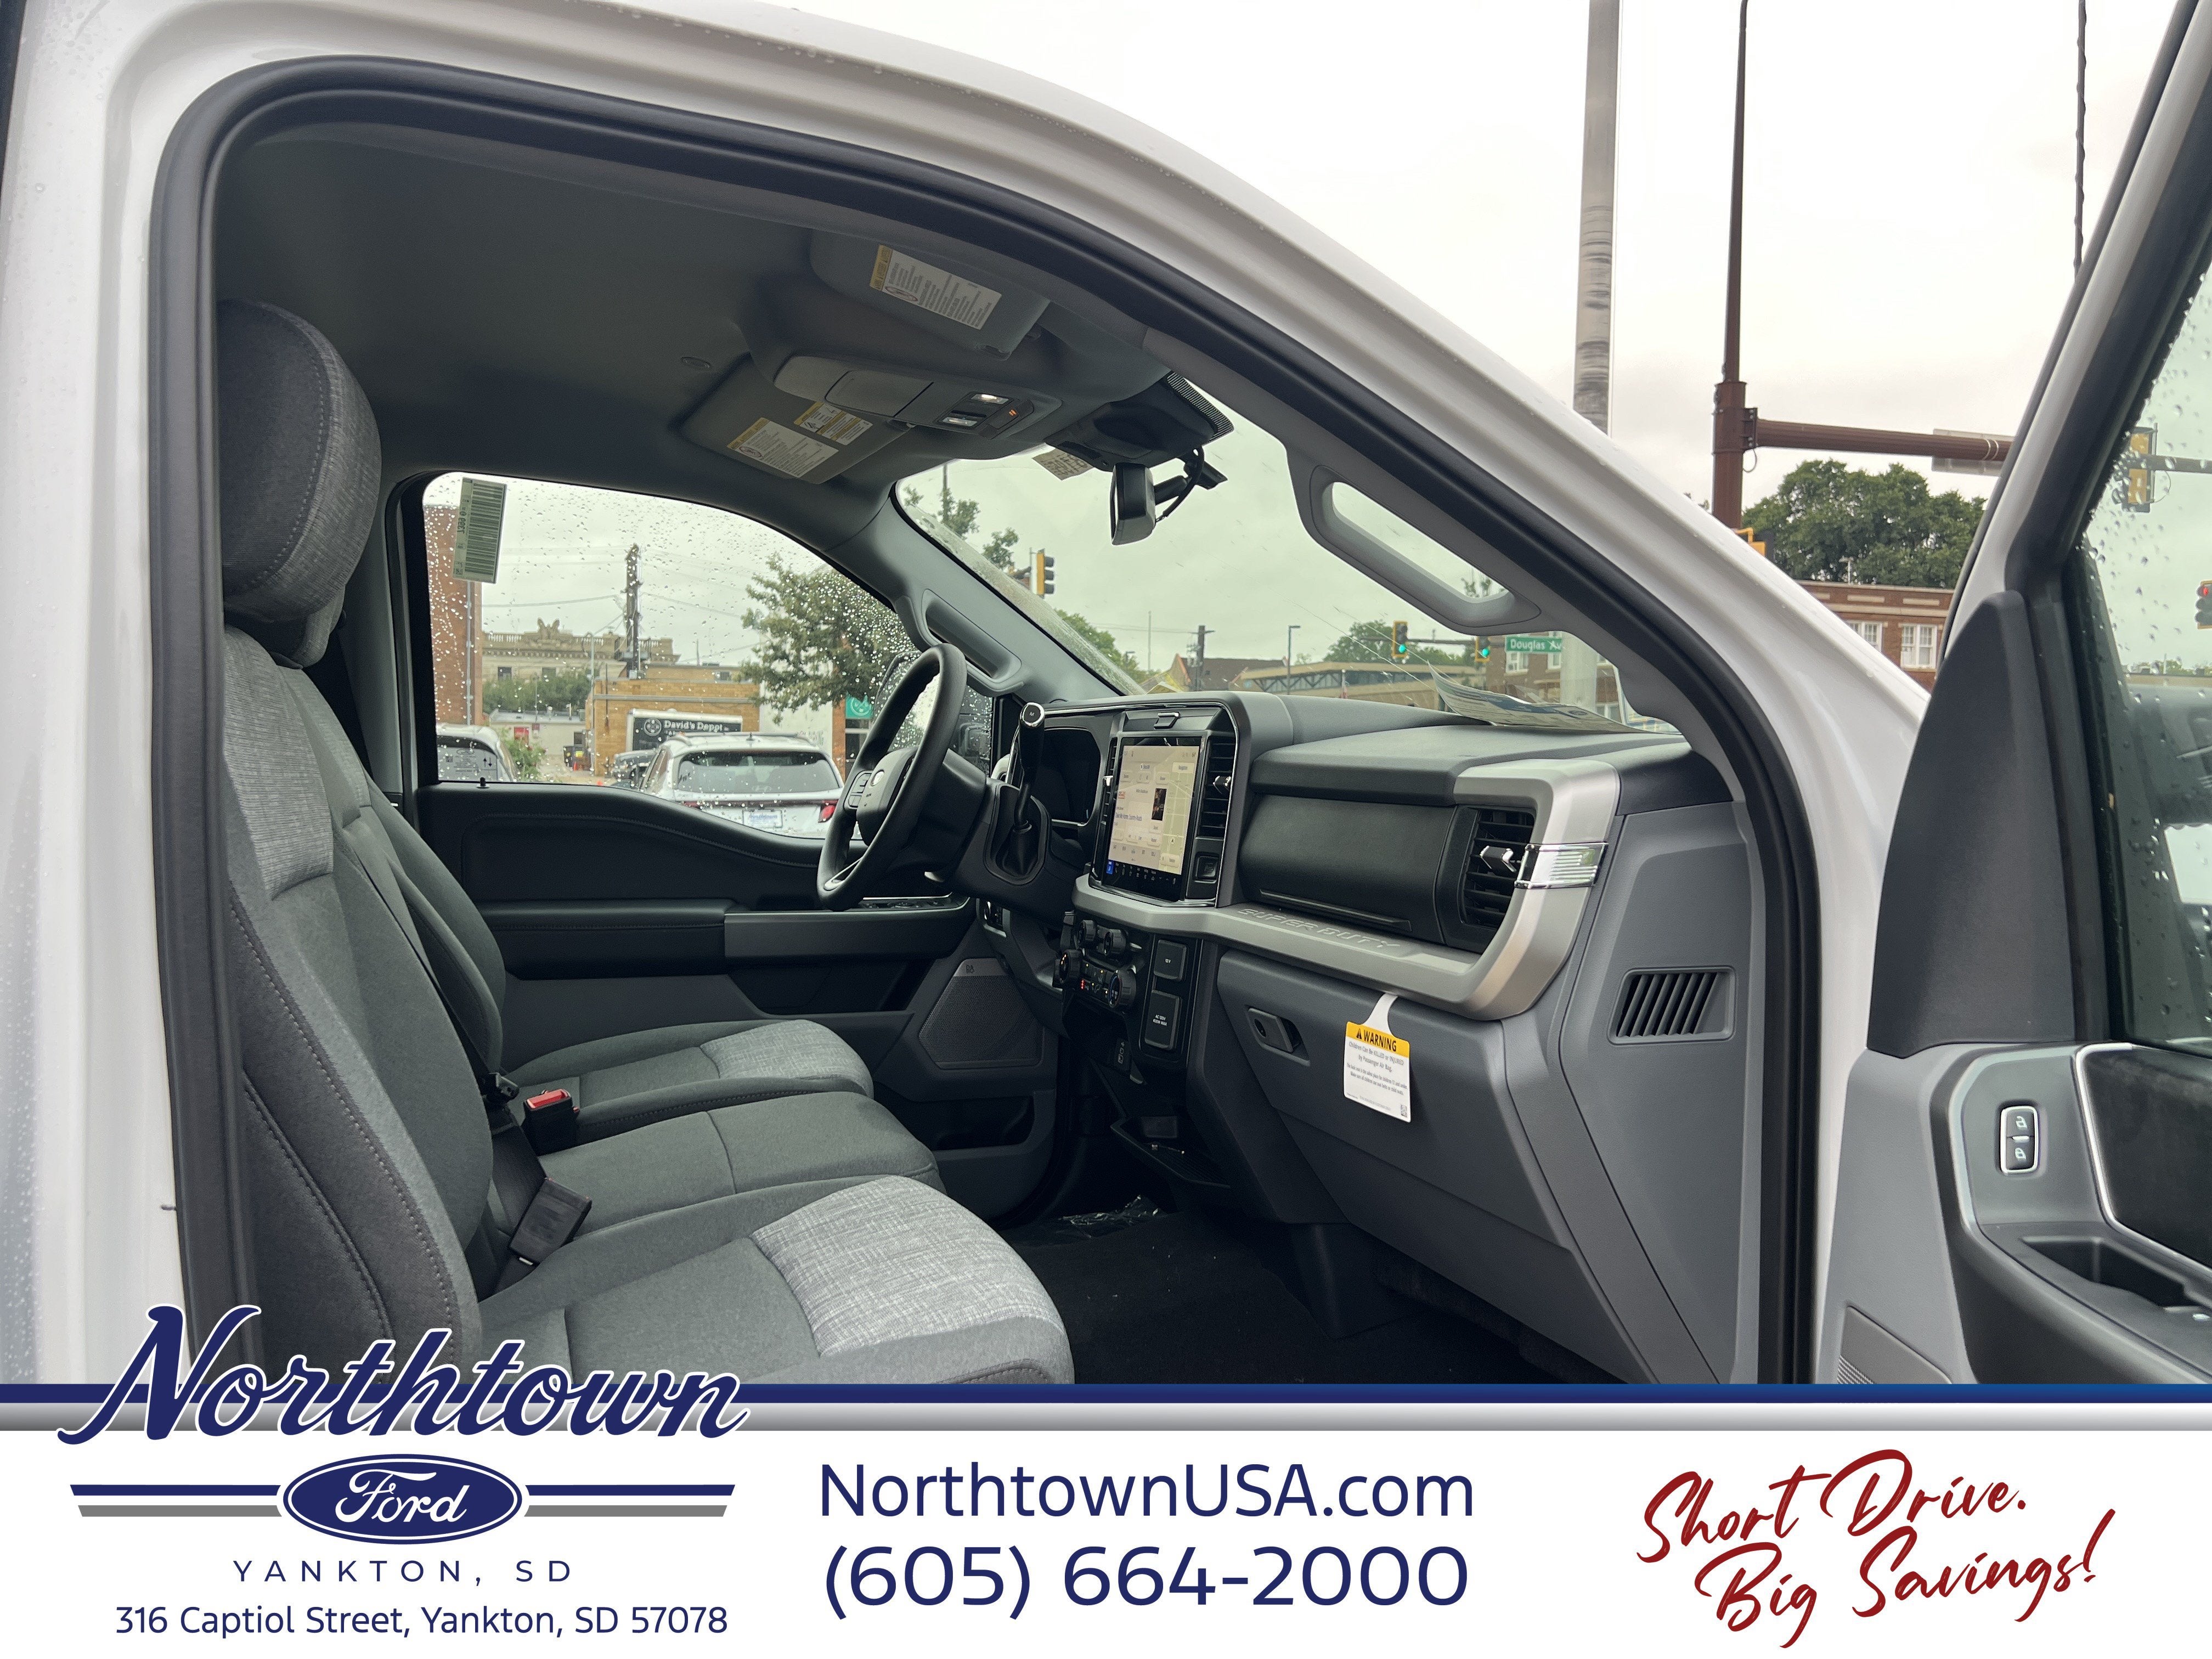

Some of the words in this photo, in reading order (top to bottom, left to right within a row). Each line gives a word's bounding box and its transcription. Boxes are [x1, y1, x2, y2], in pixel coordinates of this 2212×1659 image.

[1510, 638, 1545, 652] Douglas
[1549, 640, 1561, 651] Av
[664, 720, 695, 729] David's
[1364, 1030, 1397, 1052] WARNING
